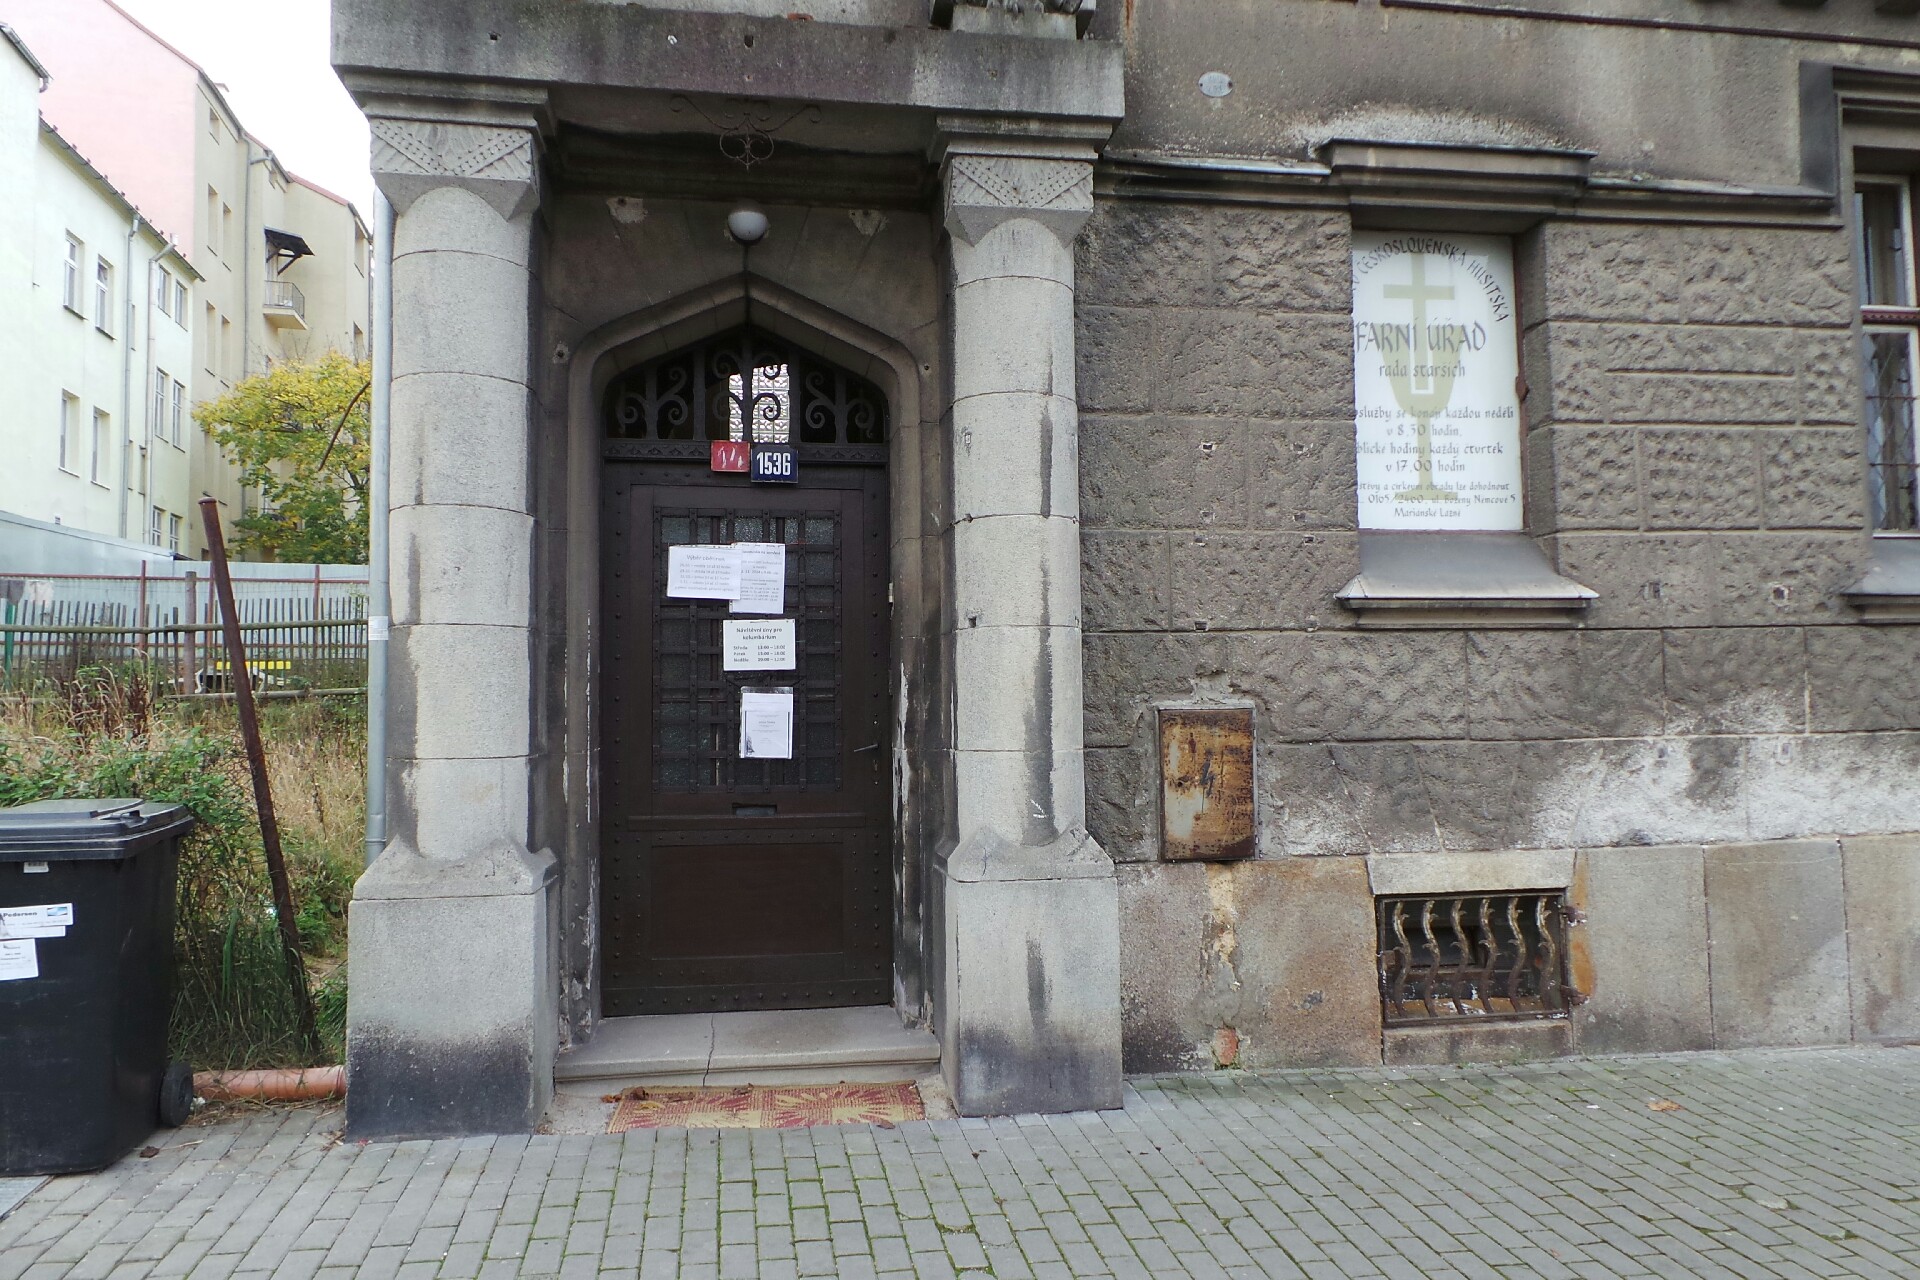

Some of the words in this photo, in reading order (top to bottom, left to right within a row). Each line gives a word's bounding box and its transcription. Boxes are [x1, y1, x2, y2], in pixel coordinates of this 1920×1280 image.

[1355, 317, 1419, 353] FARNÍ
[1427, 317, 1487, 353] ÚŘAD
[1379, 360, 1408, 377] rada
[757, 451, 791, 476] 1536
[1386, 463, 1392, 472] v
[1438, 460, 1466, 472] hodin
